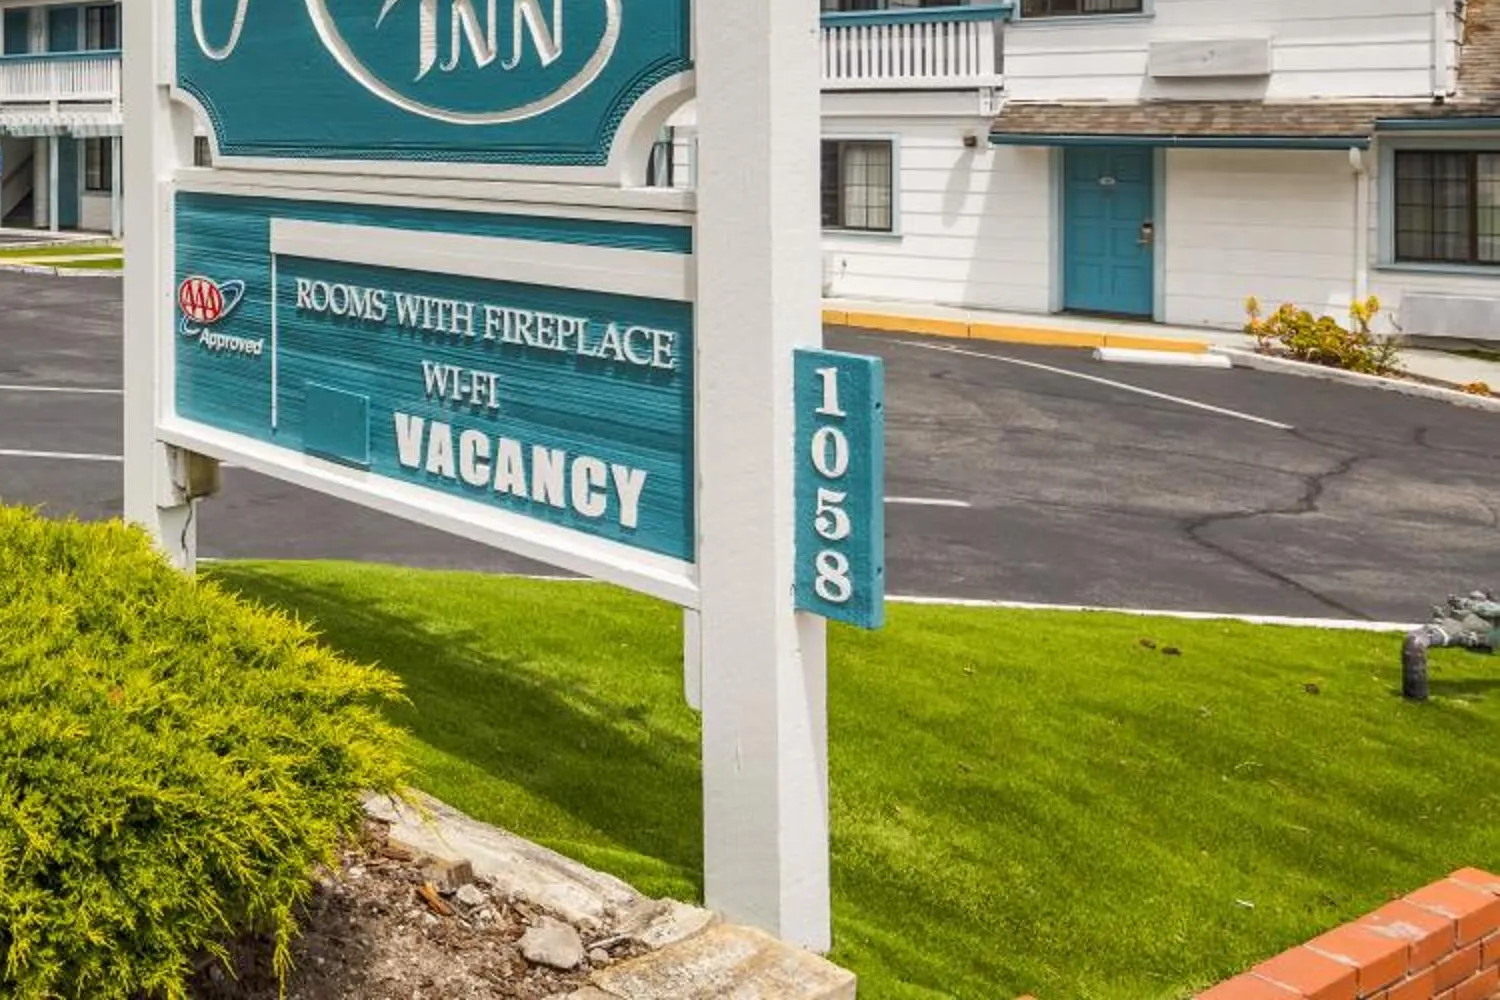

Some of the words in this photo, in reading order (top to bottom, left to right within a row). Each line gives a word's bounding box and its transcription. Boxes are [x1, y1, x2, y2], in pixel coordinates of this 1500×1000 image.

[180, 278, 223, 321] AAA
[295, 277, 388, 322] ROOMS
[393, 291, 476, 337] WITH
[483, 304, 676, 369] FIREPLACE
[199, 327, 265, 355] Approved
[421, 360, 500, 409] WI-FI
[393, 411, 648, 530] VACANCY
[810, 366, 852, 604] 1058
